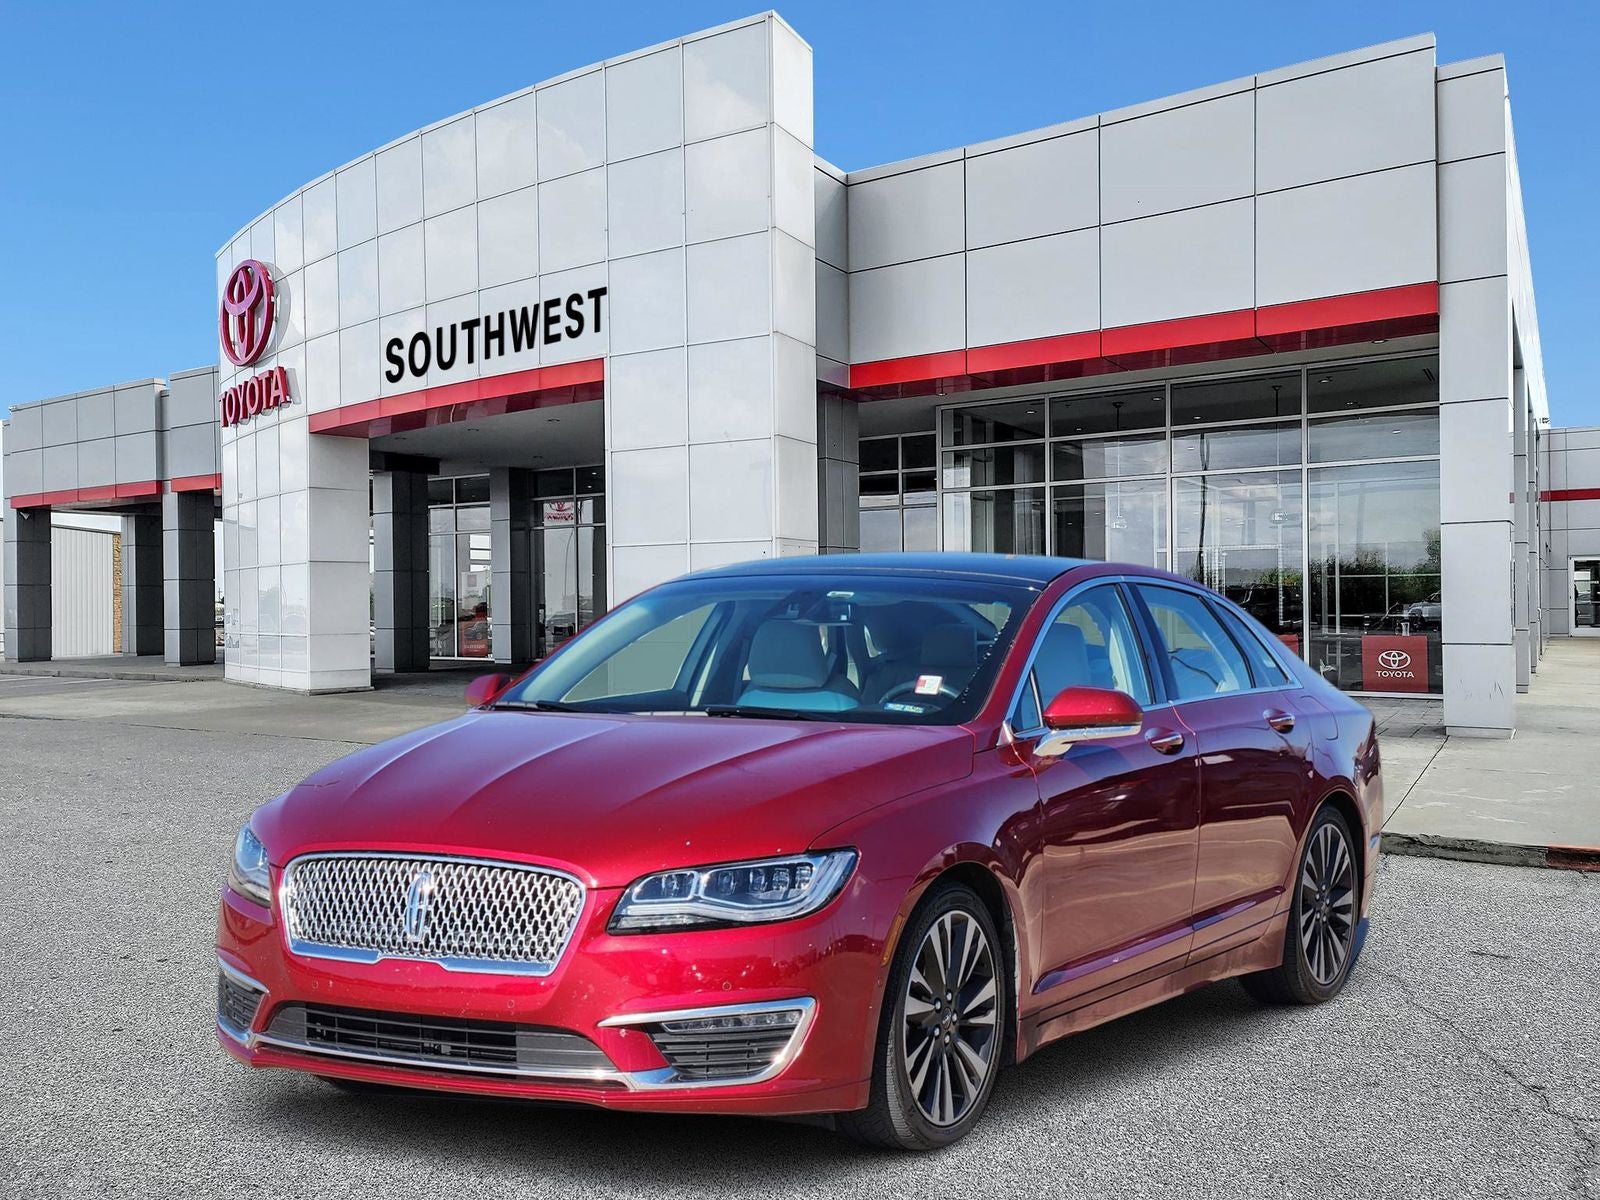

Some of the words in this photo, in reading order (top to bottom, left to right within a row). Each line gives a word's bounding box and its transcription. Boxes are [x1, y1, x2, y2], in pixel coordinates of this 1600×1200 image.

[385, 286, 608, 384] SOUTHWEST
[218, 366, 291, 428] TOYOTA
[1376, 670, 1415, 678] TOYOTA
